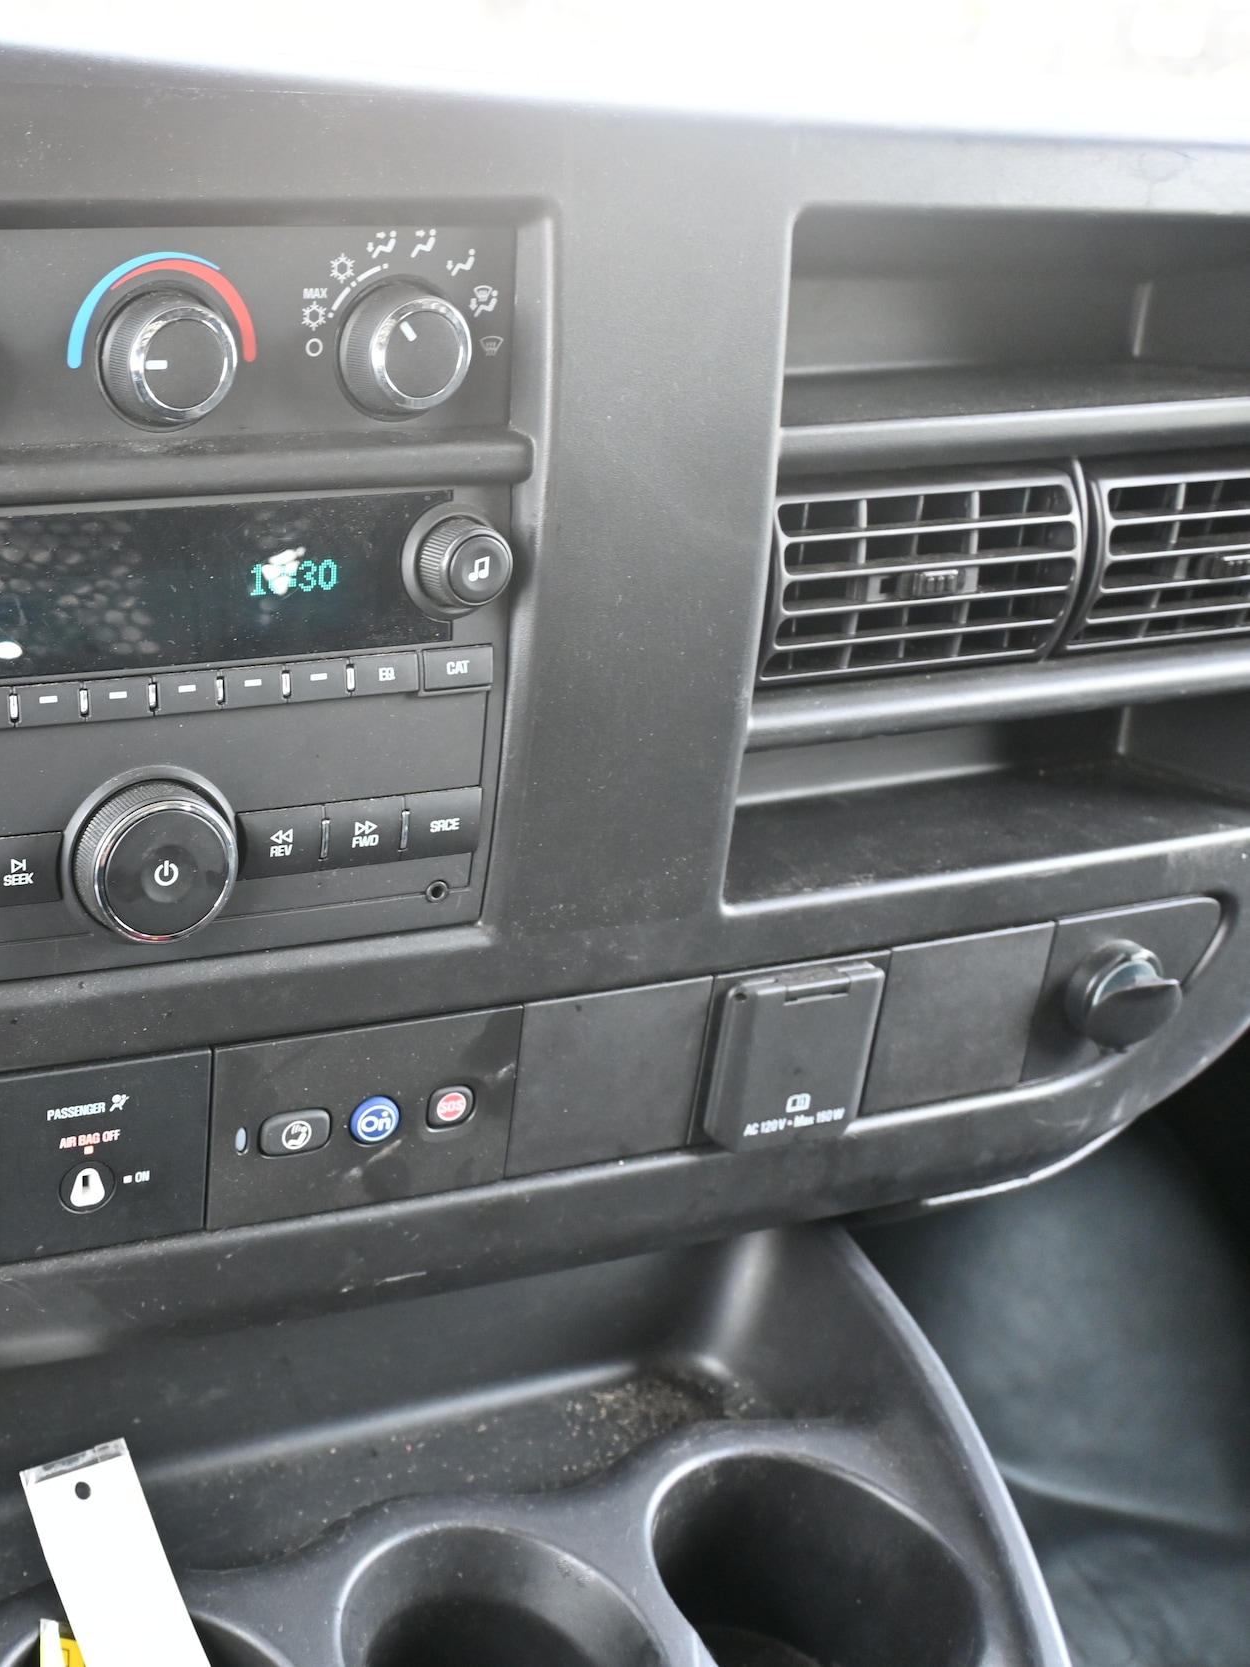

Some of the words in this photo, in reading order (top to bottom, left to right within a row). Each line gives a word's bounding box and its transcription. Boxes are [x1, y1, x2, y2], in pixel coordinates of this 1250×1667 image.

[303, 288, 327, 299] MAX
[250, 558, 338, 596] 1:30
[379, 667, 395, 681] EQ
[447, 660, 469, 675] CAT
[430, 818, 460, 832] SRCE
[352, 833, 379, 848] FWD
[270, 843, 292, 857] REV
[4, 872, 33, 886] SEEK
[47, 1102, 105, 1121] PASSENGER
[439, 1099, 465, 1114] SOS
[360, 1110, 392, 1133] On
[744, 1123, 759, 1136] AC
[793, 1115, 814, 1127] Max
[59, 1136, 77, 1149] AIR
[78, 1133, 100, 1147] BAG
[102, 1129, 120, 1142] OFF
[135, 1171, 150, 1182] ON
